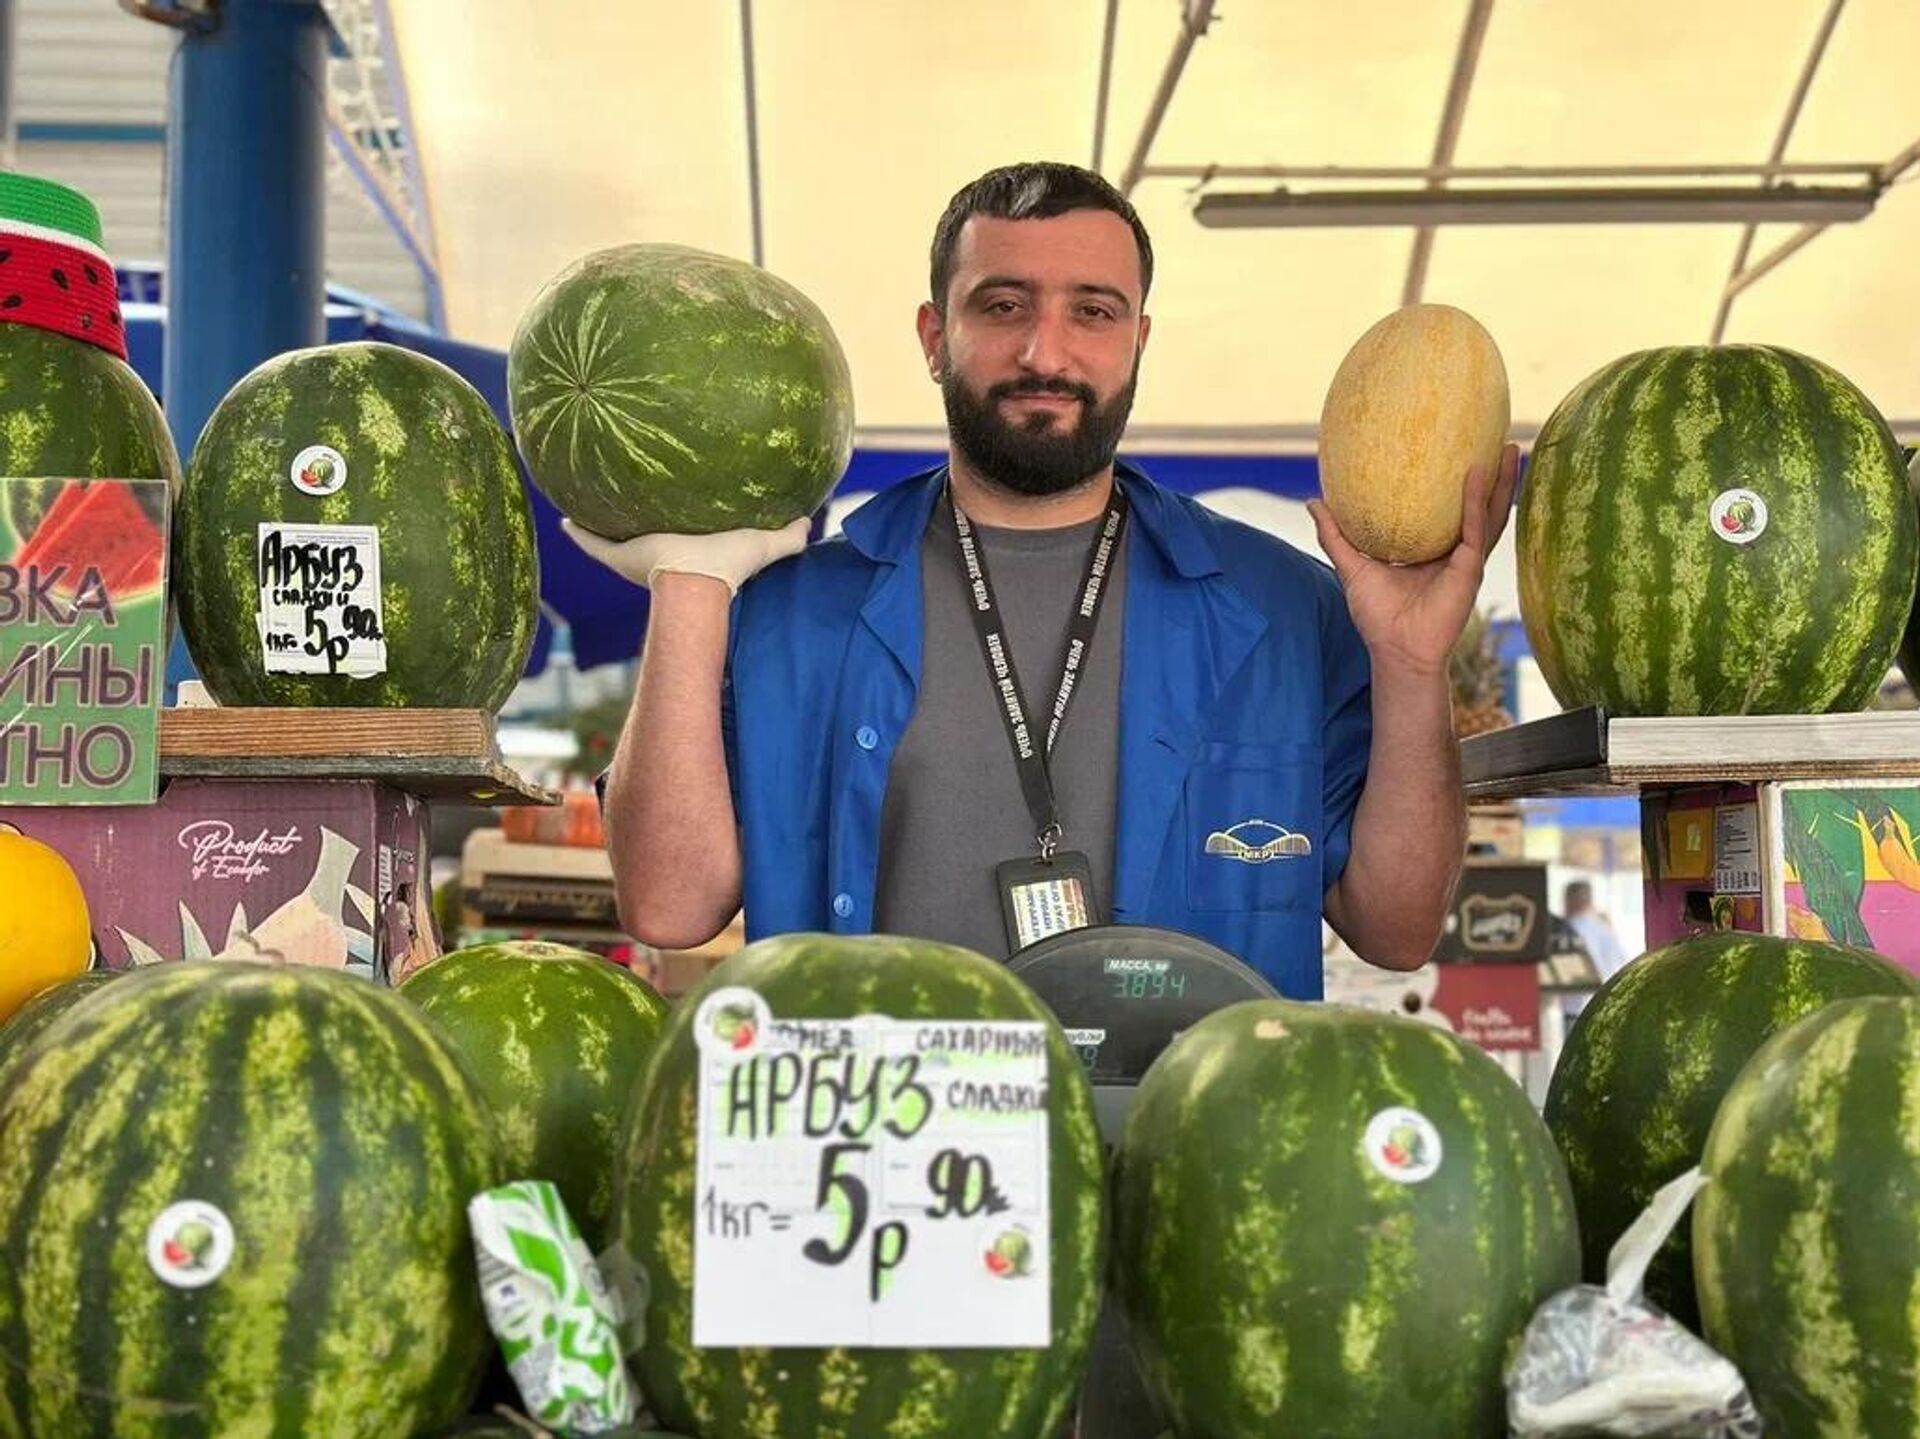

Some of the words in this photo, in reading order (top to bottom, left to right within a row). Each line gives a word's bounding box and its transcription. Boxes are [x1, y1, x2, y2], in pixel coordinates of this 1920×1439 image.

[0, 644, 150, 705] ИНЫ
[987, 634, 1008, 678] ЧЕЛОВЕК
[998, 678, 1024, 724] ЗАНЯТОЙ
[0, 724, 133, 787] ТНО
[1015, 724, 1032, 758] ОЧЕНЬ
[178, 820, 302, 864] Product
